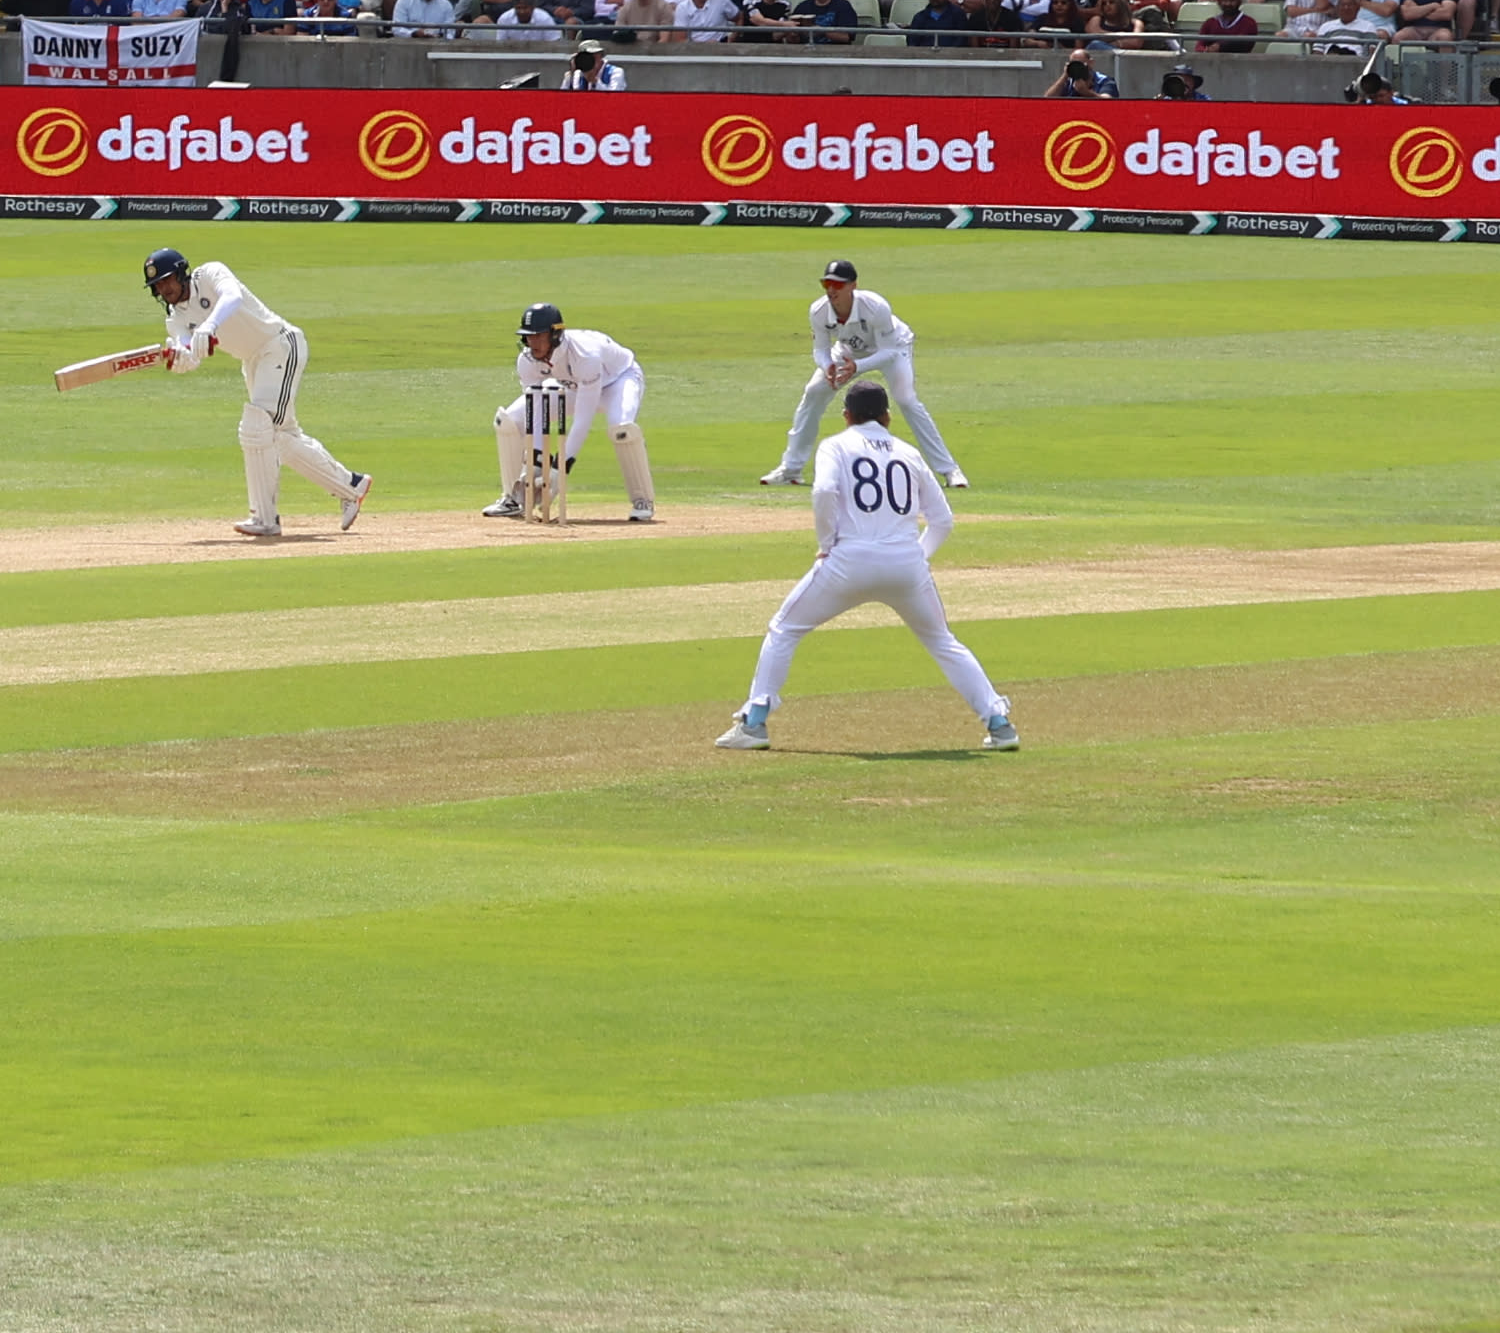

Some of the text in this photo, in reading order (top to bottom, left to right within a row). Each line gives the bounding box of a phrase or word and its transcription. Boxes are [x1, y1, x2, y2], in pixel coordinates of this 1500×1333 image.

[33, 33, 183, 60] DANNY SUZY
[50, 66, 174, 81] WALSALL
[98, 115, 308, 170] dafabet
[440, 117, 651, 173] dafabet
[783, 123, 994, 180] dafabet
[1124, 129, 1339, 185] dafabet
[5, 198, 85, 215] Rothesay
[249, 201, 328, 217] Rothesay
[491, 203, 571, 219] Rothesay
[737, 205, 818, 221] Rothesay
[983, 209, 1062, 226] Rothesay
[1227, 216, 1309, 234] Rothesay
[116, 350, 160, 372] MRF
[863, 437, 893, 453] POPE
[852, 457, 913, 516] 80
